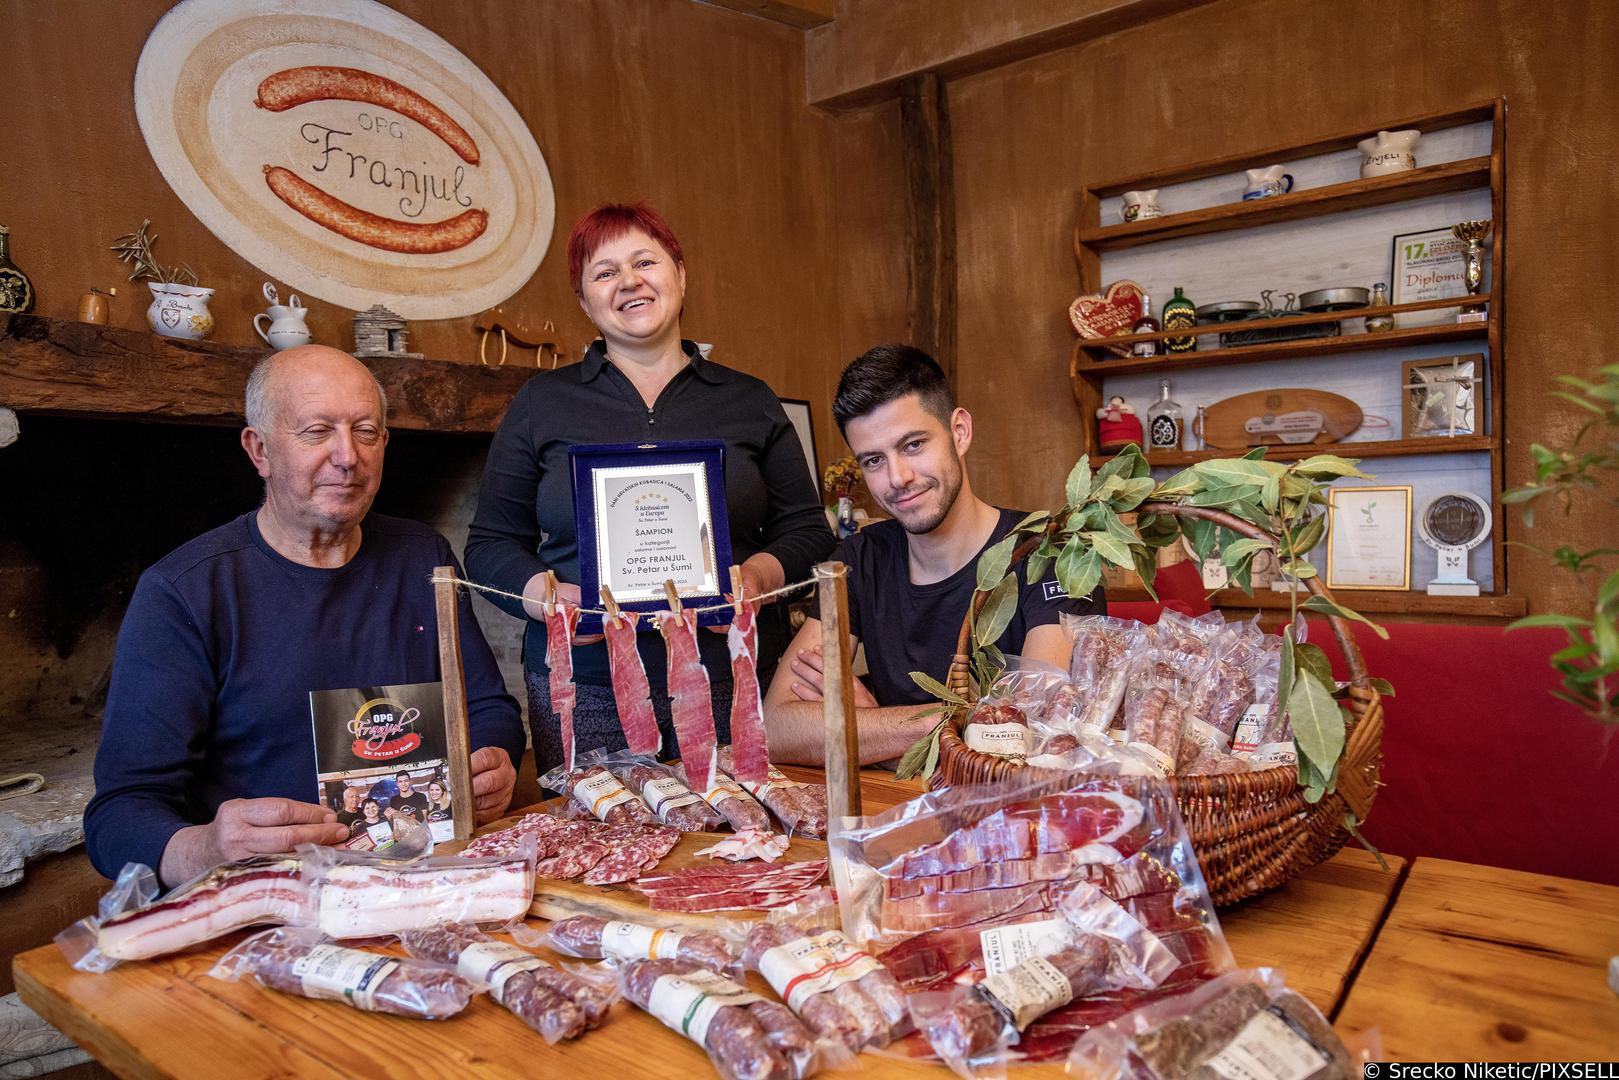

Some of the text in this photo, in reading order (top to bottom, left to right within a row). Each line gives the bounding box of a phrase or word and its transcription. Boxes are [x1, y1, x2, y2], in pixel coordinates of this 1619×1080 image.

[358, 113, 403, 139] OPG
[301, 123, 472, 217] Franjul
[1405, 243, 1428, 260] 17.
[635, 527, 673, 536] ŠAMPION
[626, 553, 686, 565] OPG FRANJUL
[622, 567, 635, 575] Sv.
[637, 565, 660, 574] Petar
[670, 562, 692, 571] Šumi
[373, 713, 394, 723] OPG
